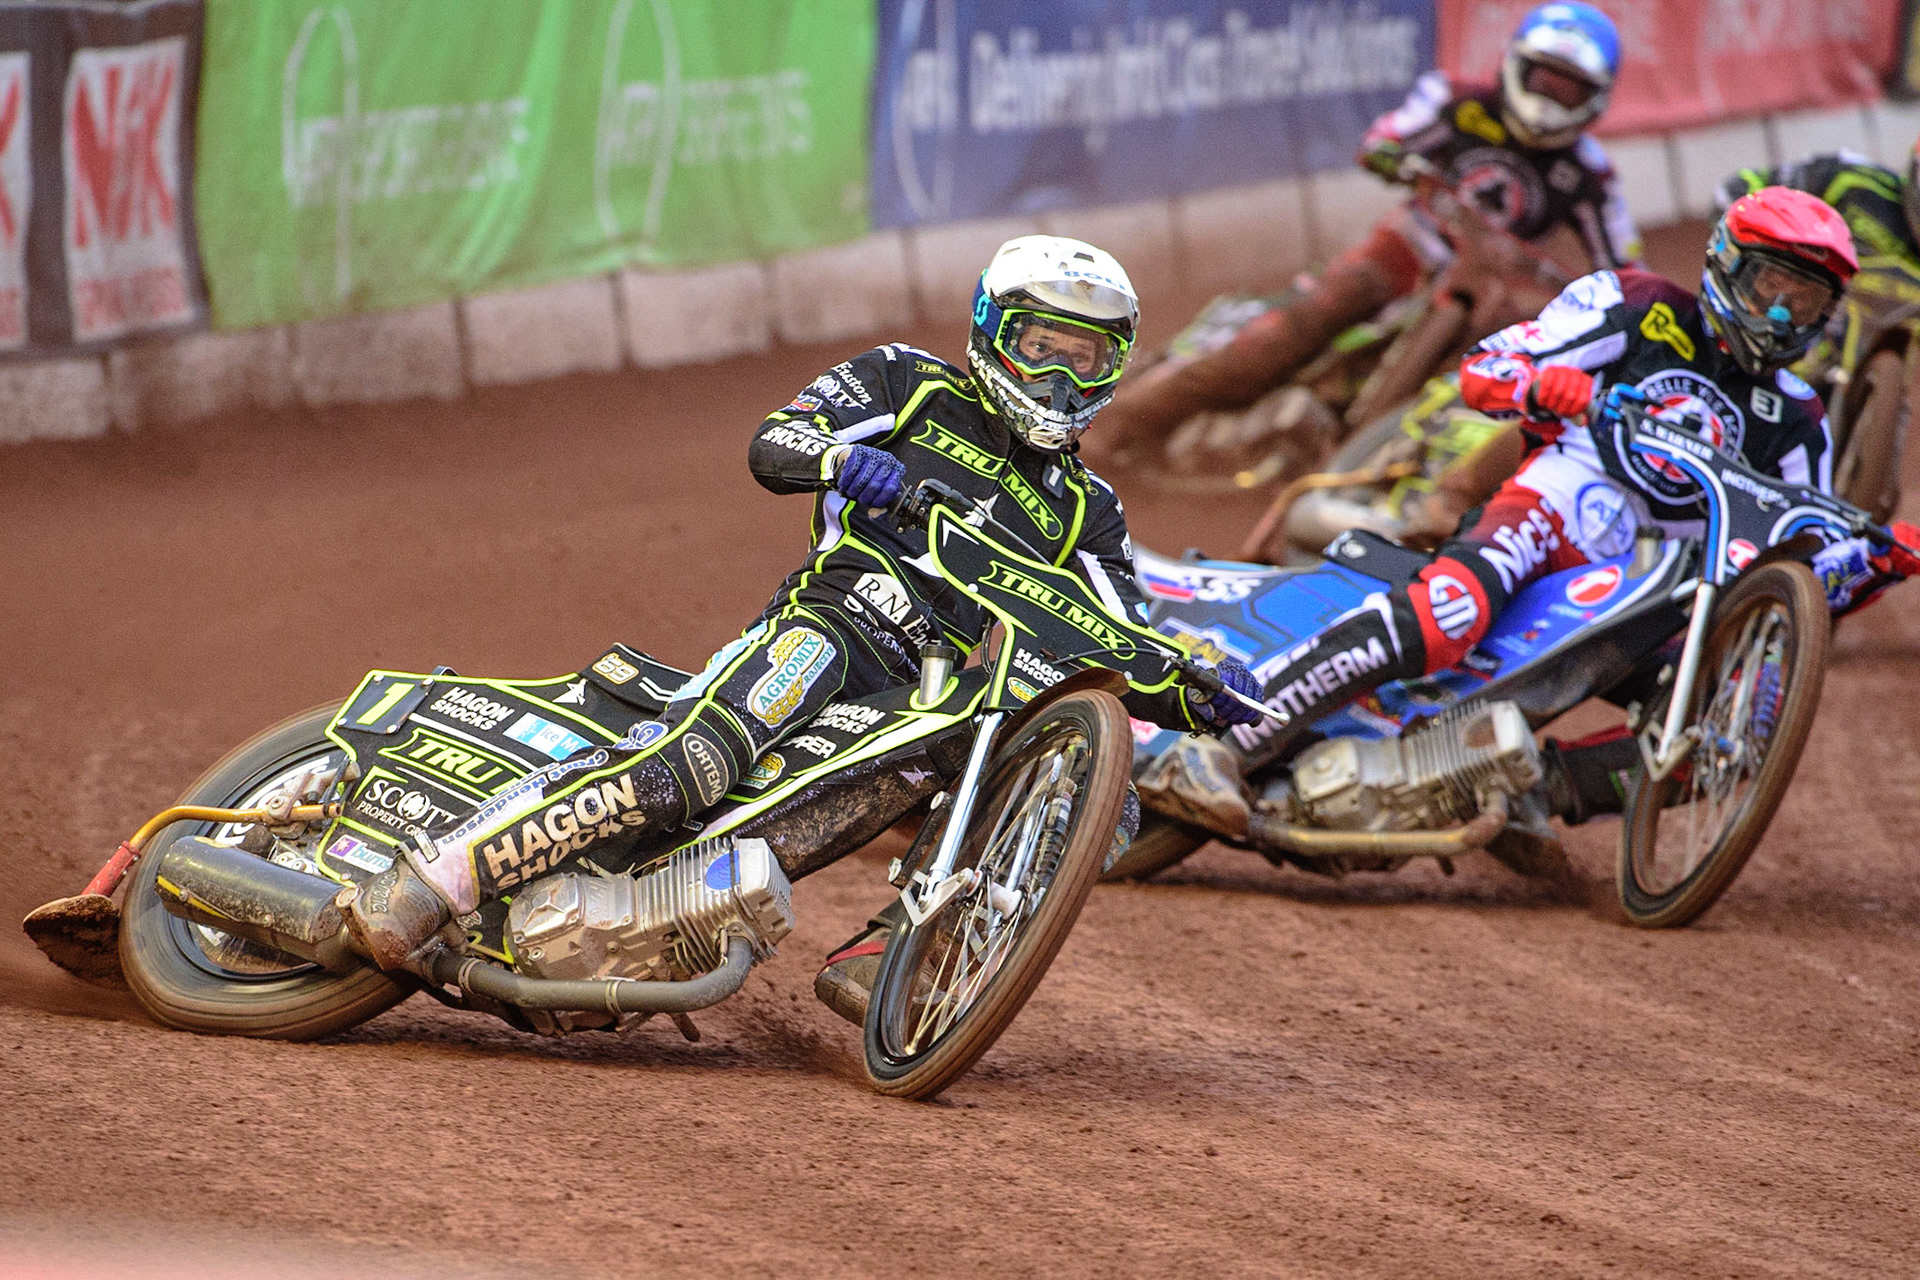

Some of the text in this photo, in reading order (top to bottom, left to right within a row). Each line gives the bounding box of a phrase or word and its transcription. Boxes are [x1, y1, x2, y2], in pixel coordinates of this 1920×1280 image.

[831, 361, 873, 405] Euston
[760, 426, 829, 456] SHOCKS
[933, 432, 1004, 475] TRU
[1003, 471, 1056, 532] MIX
[1048, 464, 1062, 487] 1
[857, 578, 911, 621] R.N.
[1001, 570, 1067, 611] TRU
[1065, 605, 1127, 650] MIX
[758, 635, 822, 710] AGROMIX
[1012, 658, 1056, 688] SHOC
[1015, 648, 1066, 683] HAGO
[356, 682, 416, 726] 1
[430, 700, 498, 731] SHOCKS
[442, 686, 515, 722] HAGON
[540, 727, 560, 743] Ice
[408, 738, 504, 785] TRU
[687, 739, 724, 802] ORTEMA
[356, 800, 408, 834] PROPERTY
[442, 774, 548, 845] Henderson
[483, 773, 639, 879] HAGON
[496, 809, 647, 891] SHOCKS
